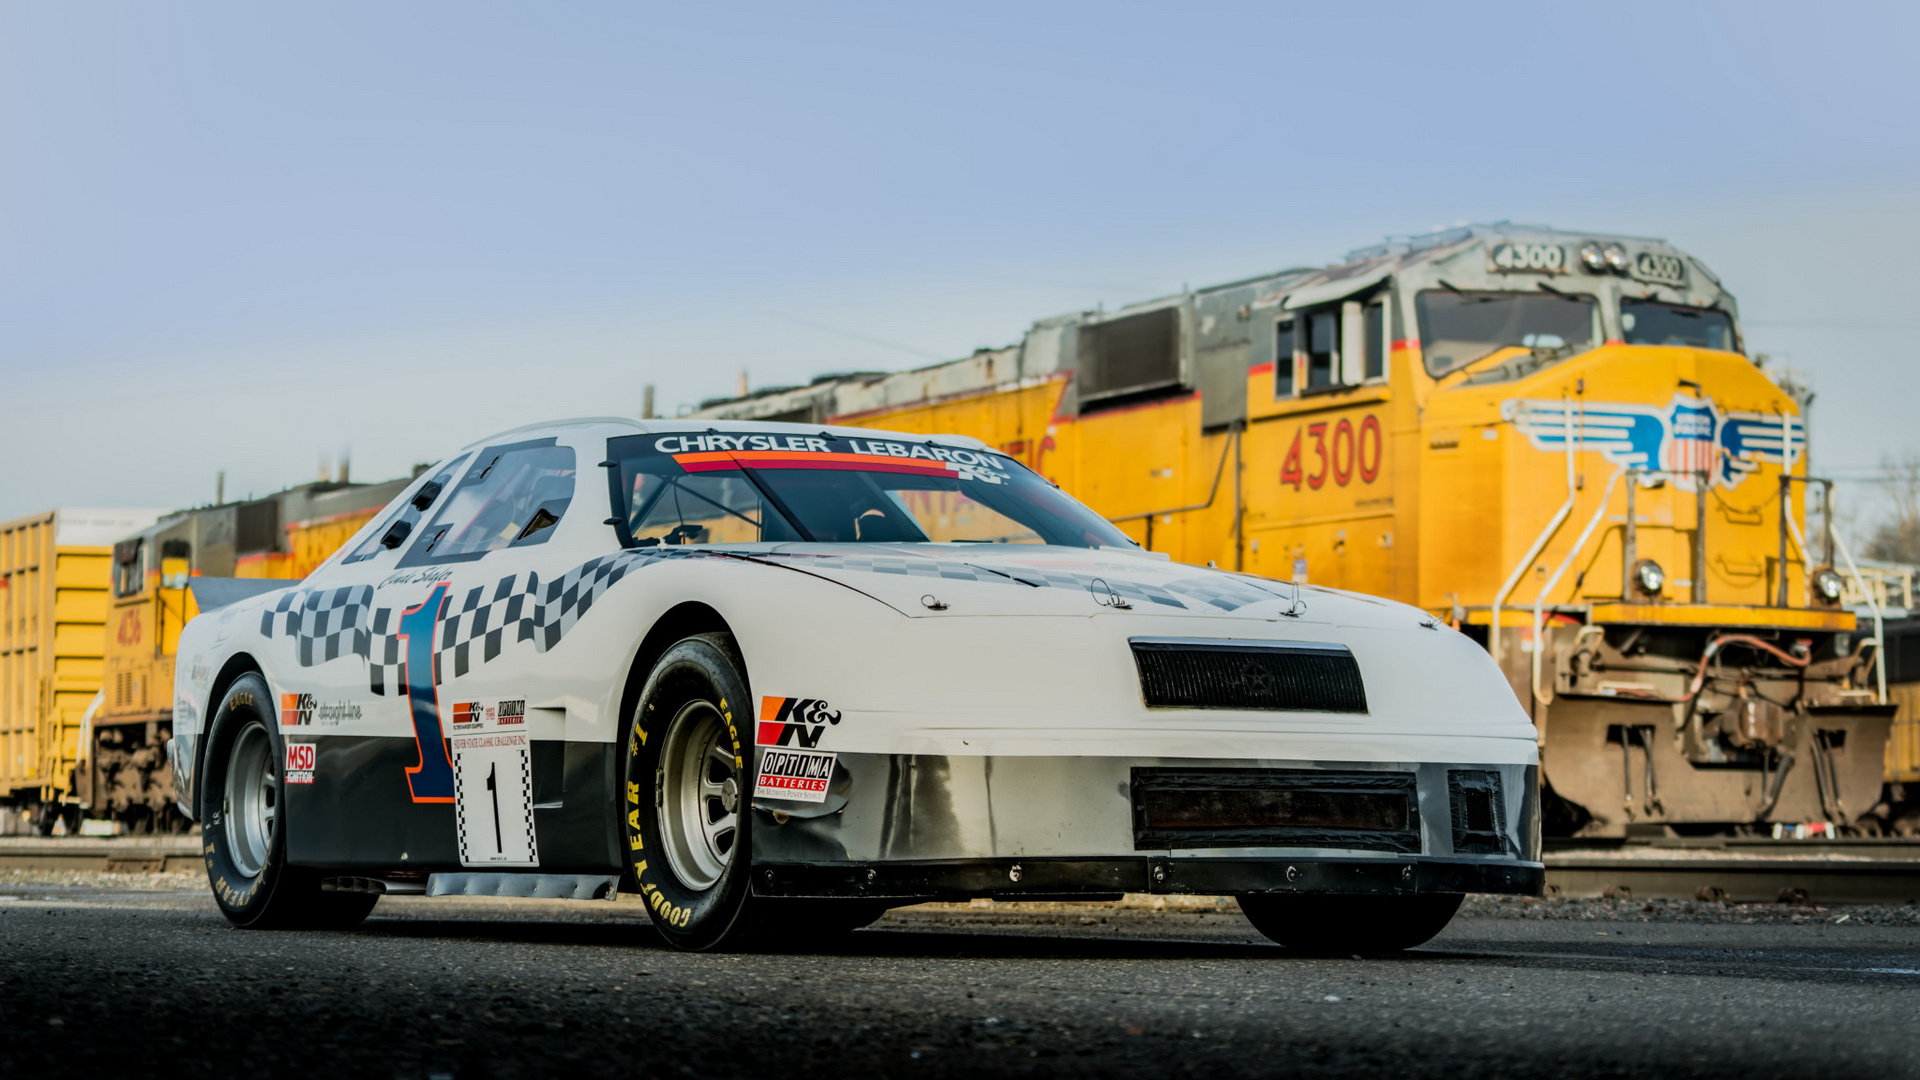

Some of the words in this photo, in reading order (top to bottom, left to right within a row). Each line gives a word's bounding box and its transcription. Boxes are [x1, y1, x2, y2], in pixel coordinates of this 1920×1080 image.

[1495, 245, 1561, 268] 4300
[1640, 255, 1680, 279] 4300
[655, 435, 831, 453] CHRYSLER
[849, 440, 1004, 470] LEBARON
[1280, 414, 1382, 492] 4300
[230, 691, 254, 711] EAGLE
[397, 582, 456, 803] 1
[630, 722, 649, 757] #1
[719, 697, 743, 769] EAGLE
[287, 745, 314, 770] MSD
[763, 752, 834, 779] OPTIMA
[760, 776, 825, 791] BATTERIES
[486, 762, 503, 854] 1
[627, 781, 691, 927] GOODYEAR
